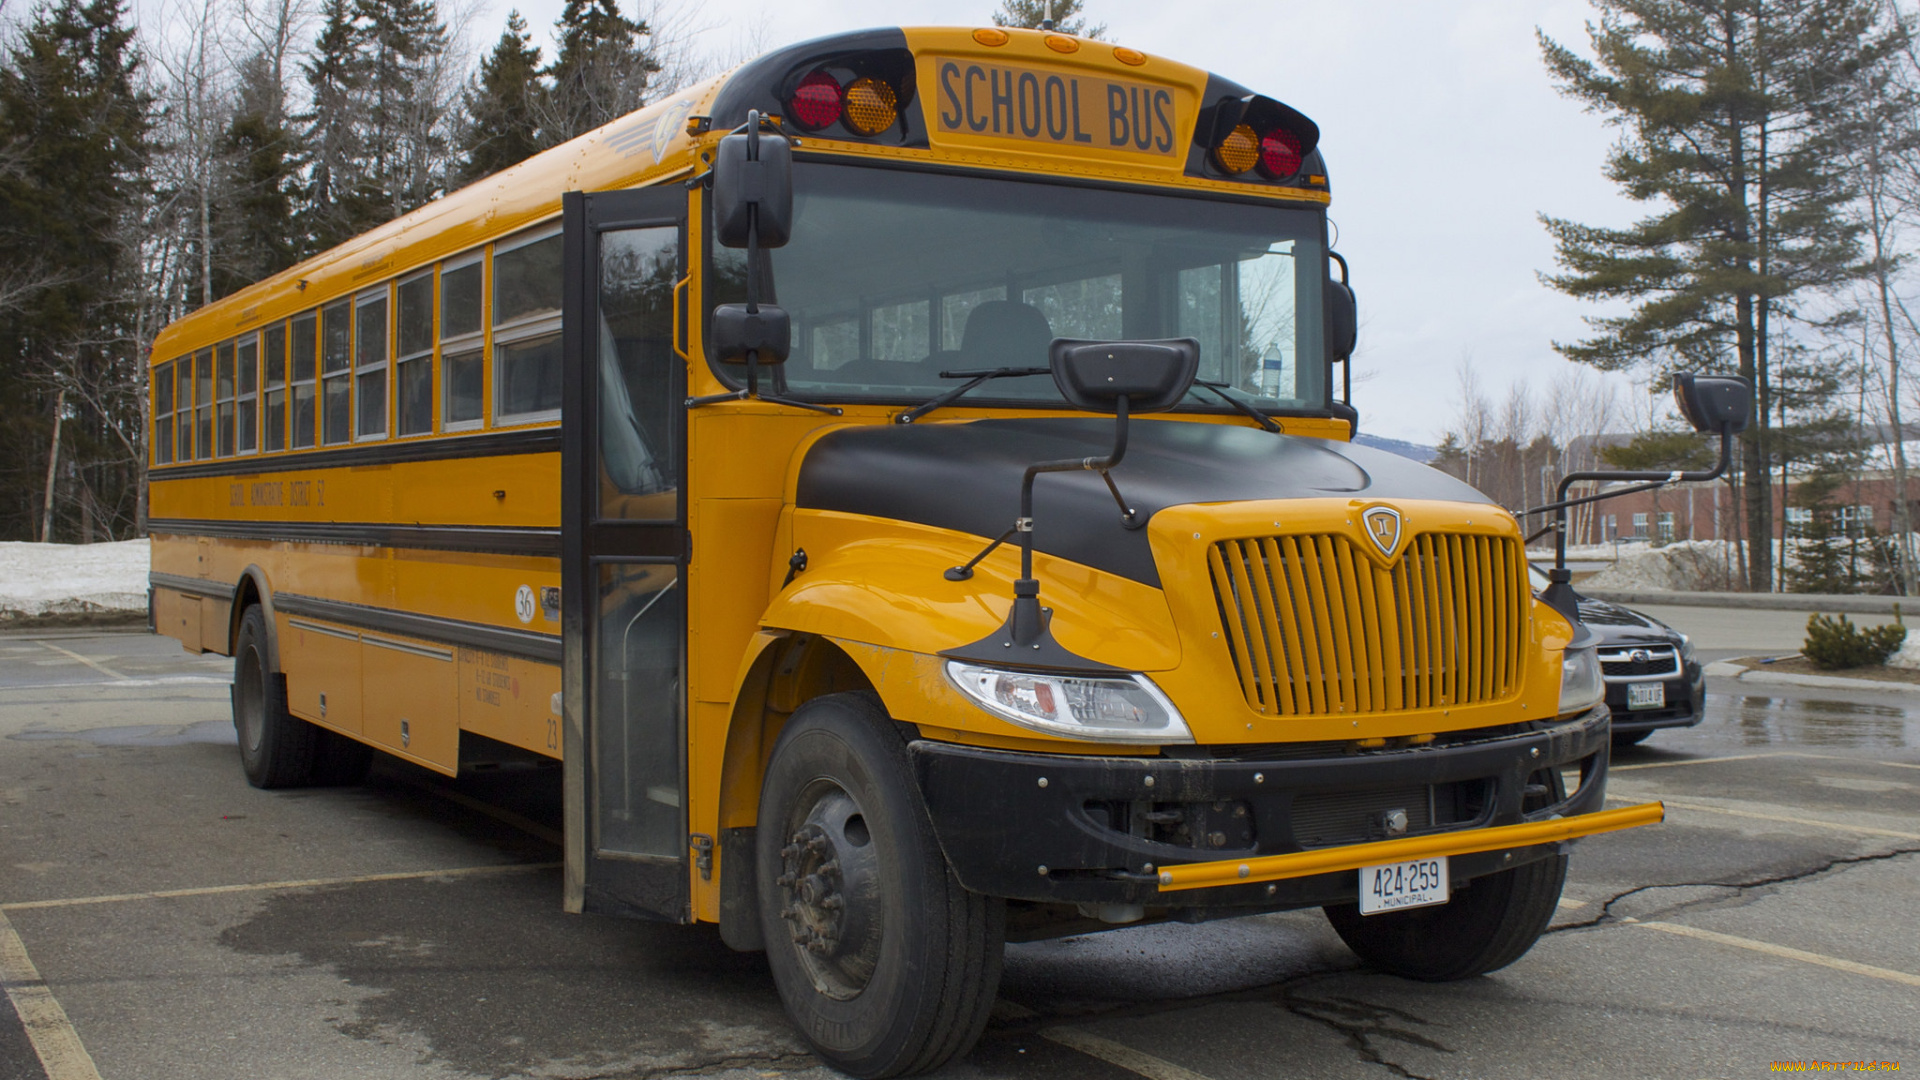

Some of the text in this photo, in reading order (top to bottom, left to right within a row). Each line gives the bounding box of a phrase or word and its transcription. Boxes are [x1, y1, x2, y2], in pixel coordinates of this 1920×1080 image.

[940, 61, 1173, 153] SCHOOL BUS
[518, 589, 532, 618] 36
[547, 718, 557, 750] 23
[1383, 894, 1428, 907] MUNICIPAL
